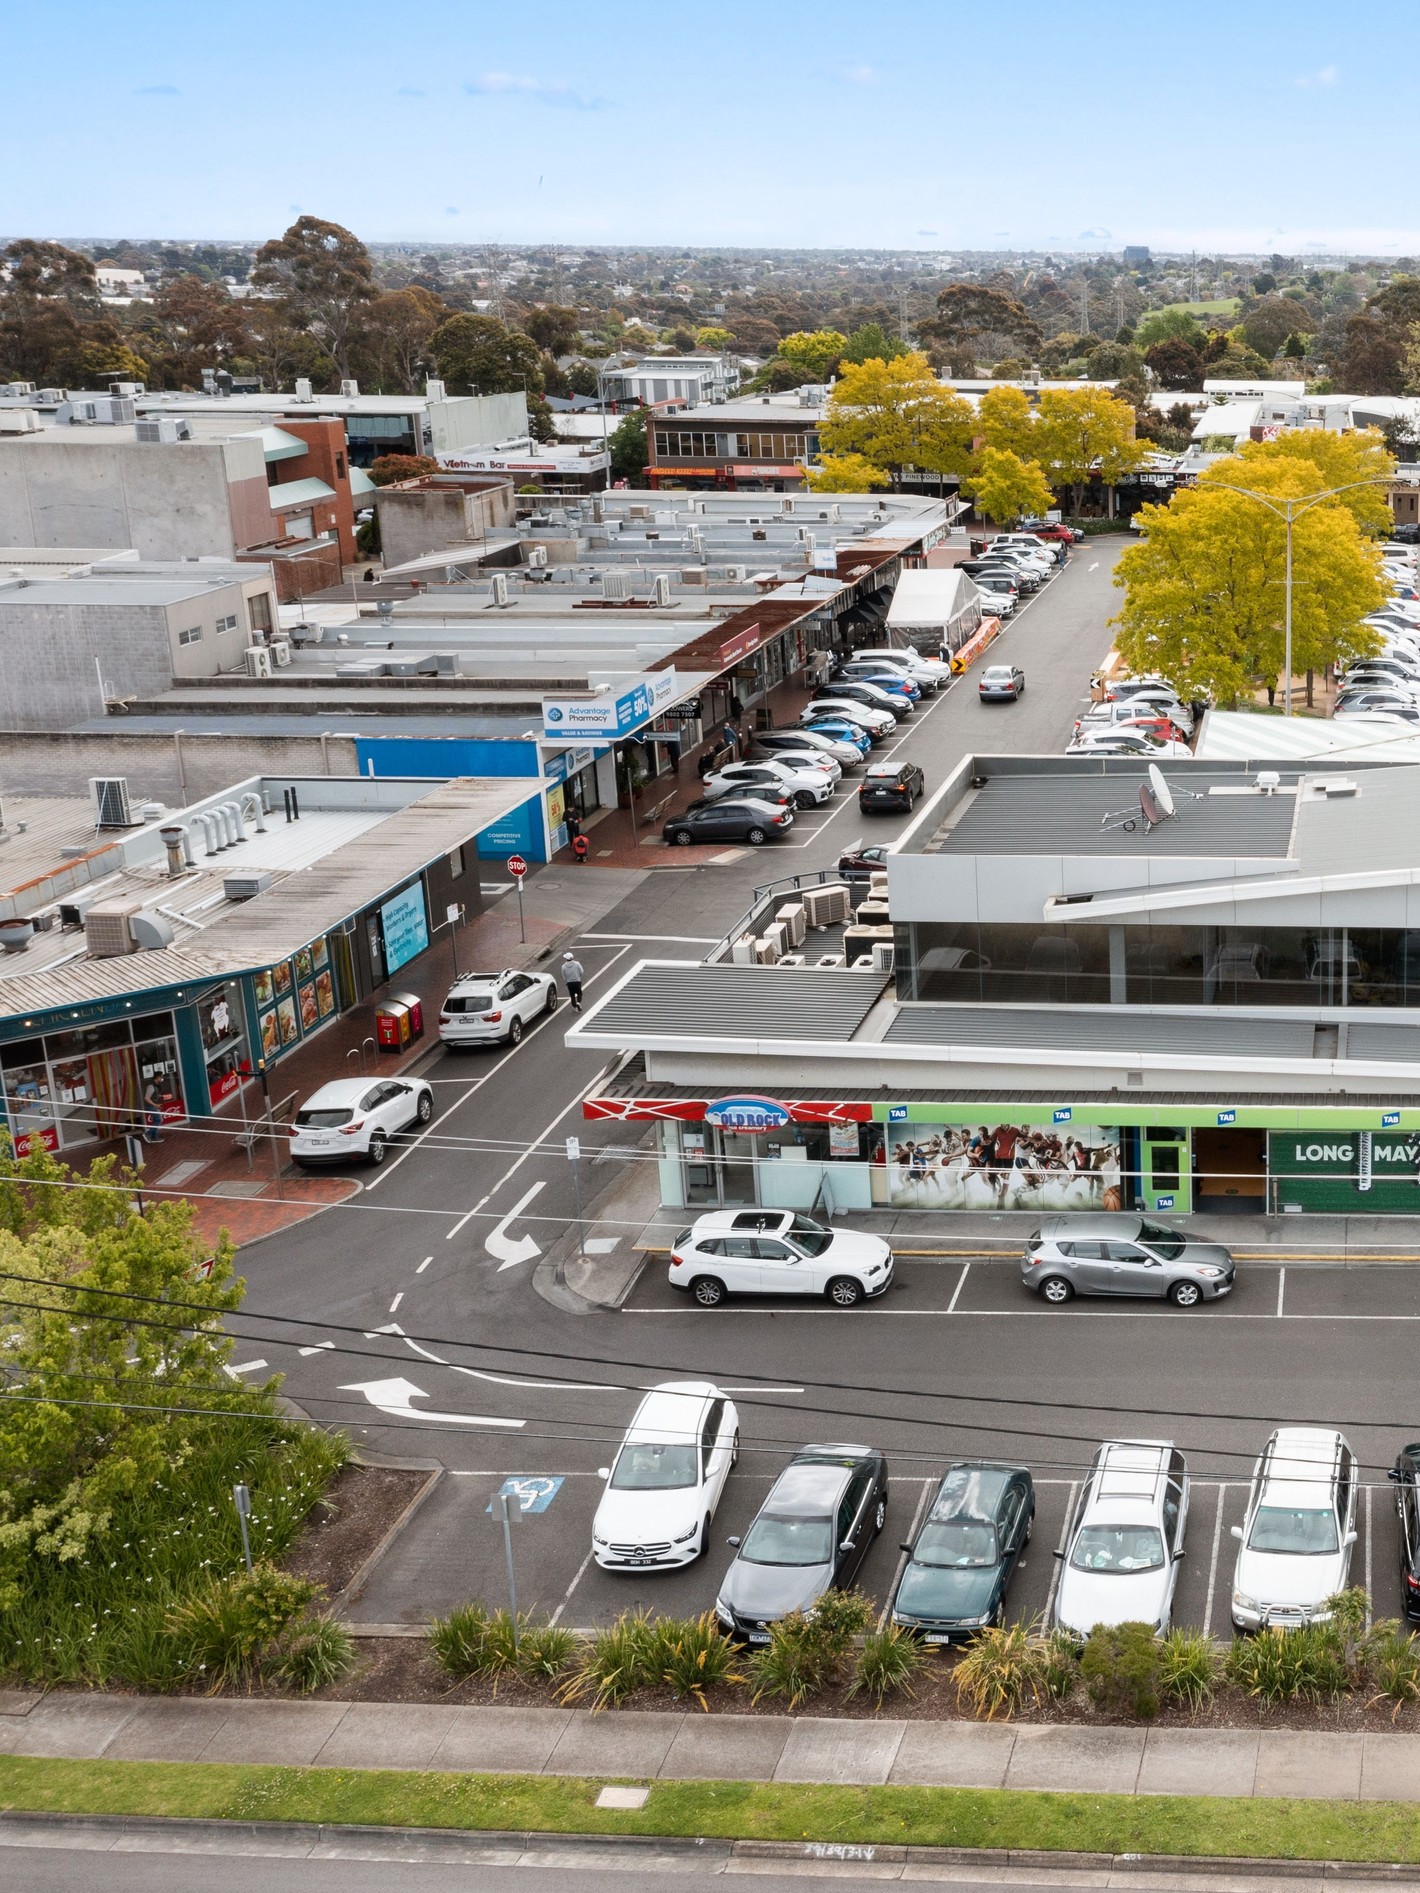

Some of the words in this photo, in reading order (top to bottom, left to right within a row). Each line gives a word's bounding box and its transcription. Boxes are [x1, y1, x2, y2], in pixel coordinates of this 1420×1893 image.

[490, 460, 506, 469] Bar
[634, 694, 648, 717] 50%
[568, 707, 611, 716] Advantage
[568, 714, 608, 723] Pharmacy
[509, 861, 526, 871] STOP
[890, 1109, 906, 1118] TAB
[1054, 1111, 1070, 1119] TAB
[1218, 1113, 1234, 1122] TAB
[712, 1113, 744, 1126] OLD
[749, 1113, 782, 1126] ROCK
[1383, 1116, 1399, 1124] TAB
[1295, 1144, 1355, 1162] LONG
[1374, 1145, 1419, 1162] MAY
[1158, 1199, 1173, 1207] TAB
